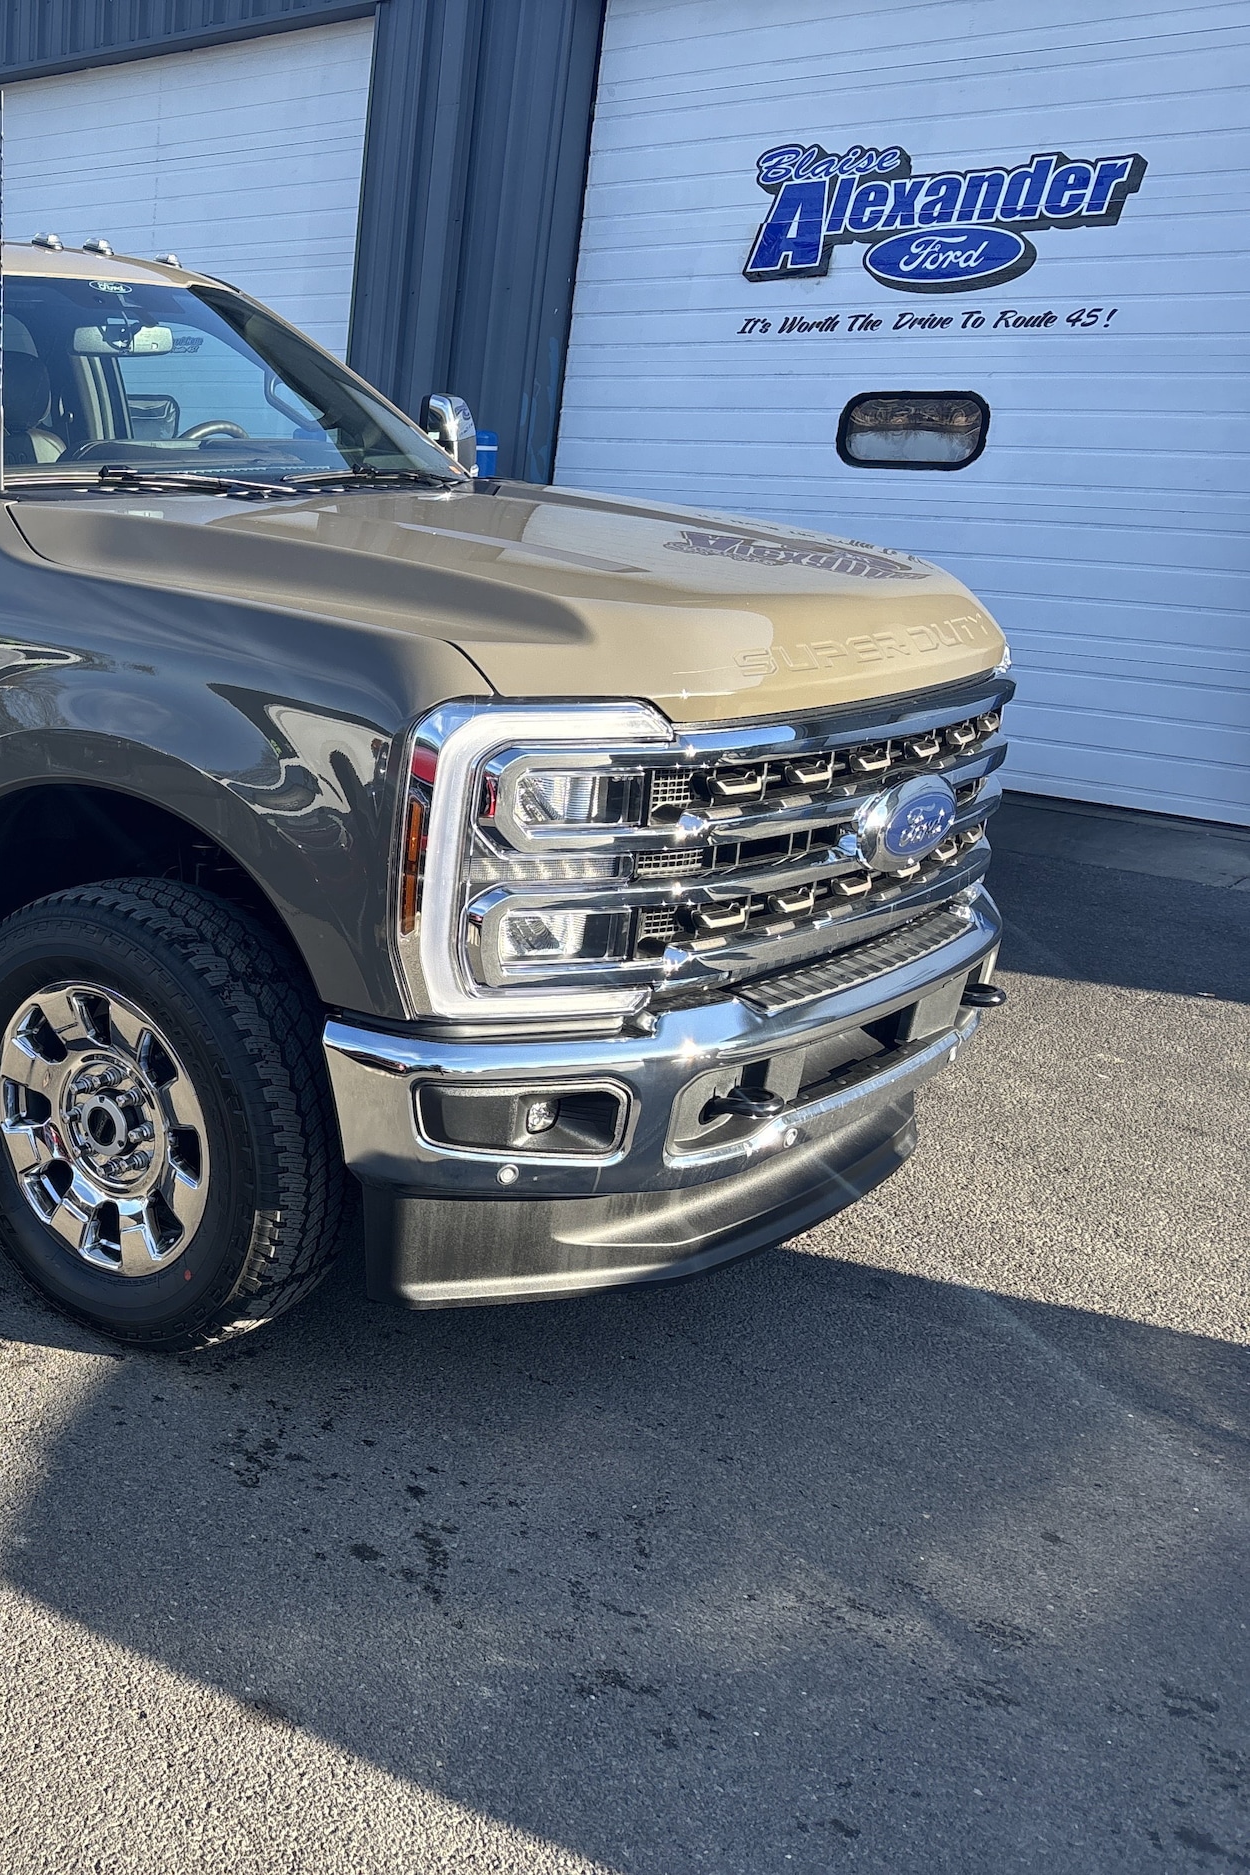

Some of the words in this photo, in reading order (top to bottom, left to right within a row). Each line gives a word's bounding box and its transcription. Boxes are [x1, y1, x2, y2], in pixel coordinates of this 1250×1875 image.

[757, 143, 904, 186] Blaise
[746, 152, 1140, 276] Alexander
[897, 233, 989, 273] Ford
[736, 316, 772, 335] It's
[776, 313, 841, 335] Worth
[847, 312, 884, 333] The
[891, 311, 954, 331] Drive
[961, 309, 986, 330] To
[992, 309, 1058, 330] Route
[732, 631, 910, 678] SUPER
[906, 612, 989, 653] DUTY
[898, 802, 946, 848] Ford
